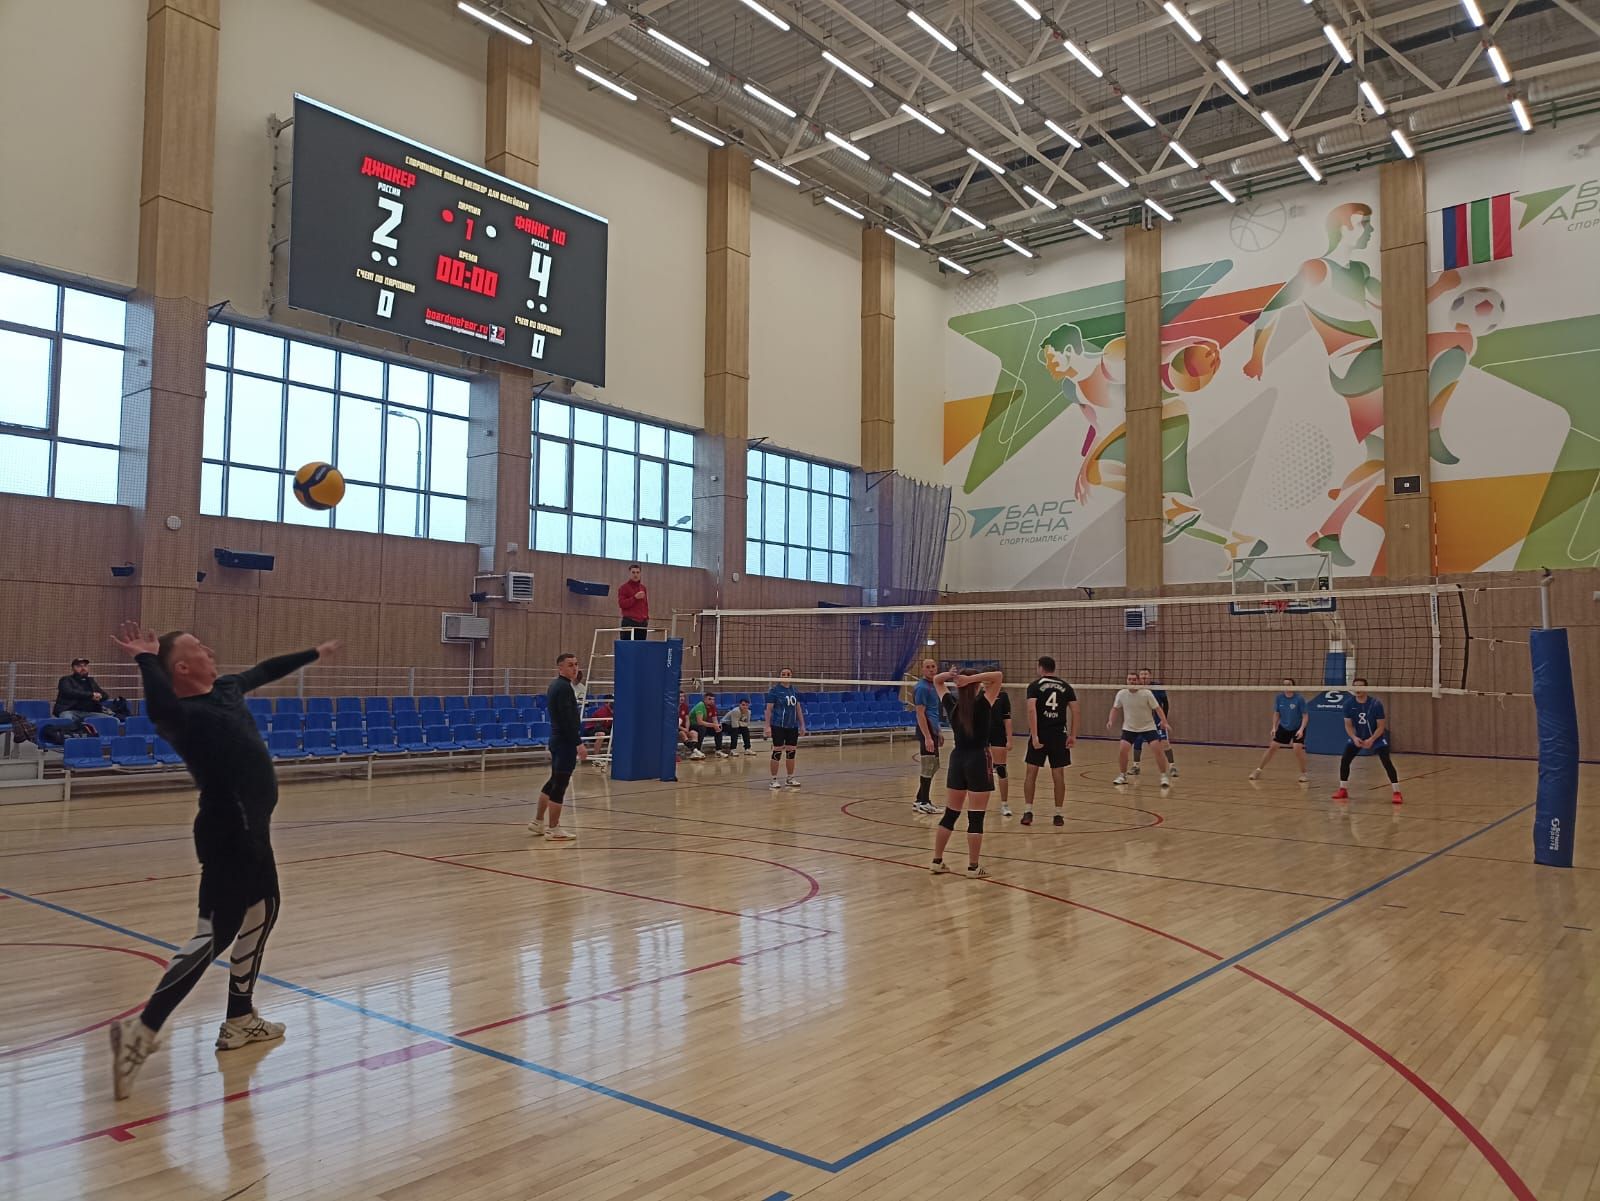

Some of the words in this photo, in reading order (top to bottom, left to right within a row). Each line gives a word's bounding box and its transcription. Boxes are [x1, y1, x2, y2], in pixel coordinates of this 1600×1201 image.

[361, 156, 416, 189] ДЖОКЕР
[372, 196, 404, 250] 2
[1542, 199, 1600, 226] АР
[466, 218, 475, 241] 1
[436, 254, 499, 298] 00:00
[529, 251, 552, 298] 4
[376, 289, 395, 318] 0
[531, 333, 546, 359] 0
[1006, 499, 1076, 519] БАРС
[985, 517, 1069, 537] АРЕНА
[1000, 535, 1069, 546] СПОРТКОМПЛЕКС
[785, 695, 797, 707] 10
[1045, 691, 1059, 711] 4
[1358, 712, 1367, 725] 8
